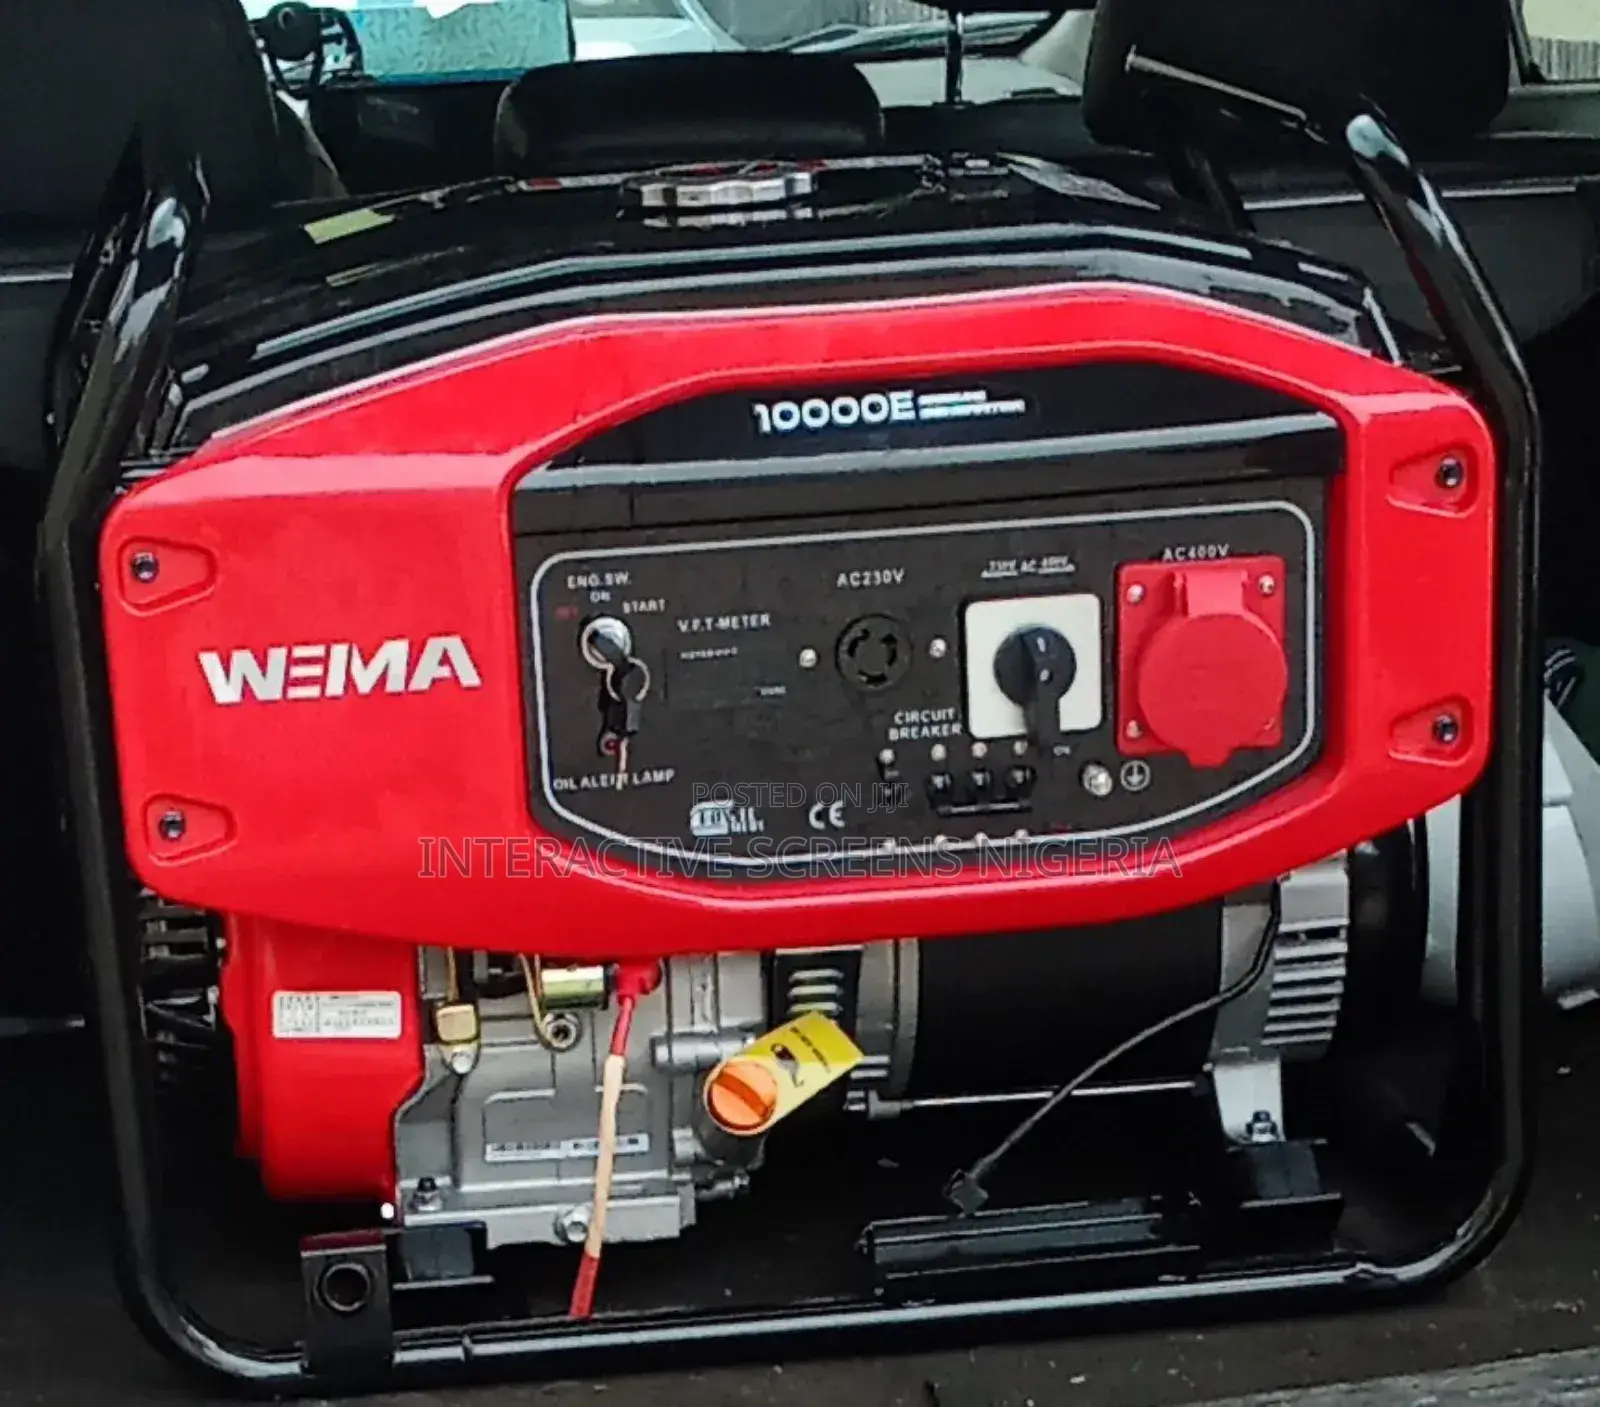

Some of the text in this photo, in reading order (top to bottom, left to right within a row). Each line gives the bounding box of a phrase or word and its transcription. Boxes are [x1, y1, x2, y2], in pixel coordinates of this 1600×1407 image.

[752, 390, 916, 434] 10000E
[1162, 543, 1230, 562] AC400V
[836, 567, 905, 589] AC230V
[623, 599, 666, 614] START
[198, 634, 482, 704] WEIMA
[893, 707, 955, 724] CIRCUIT
[888, 722, 962, 741] BREAKER
[552, 777, 578, 791] OIL
[632, 768, 675, 785] LAMP
